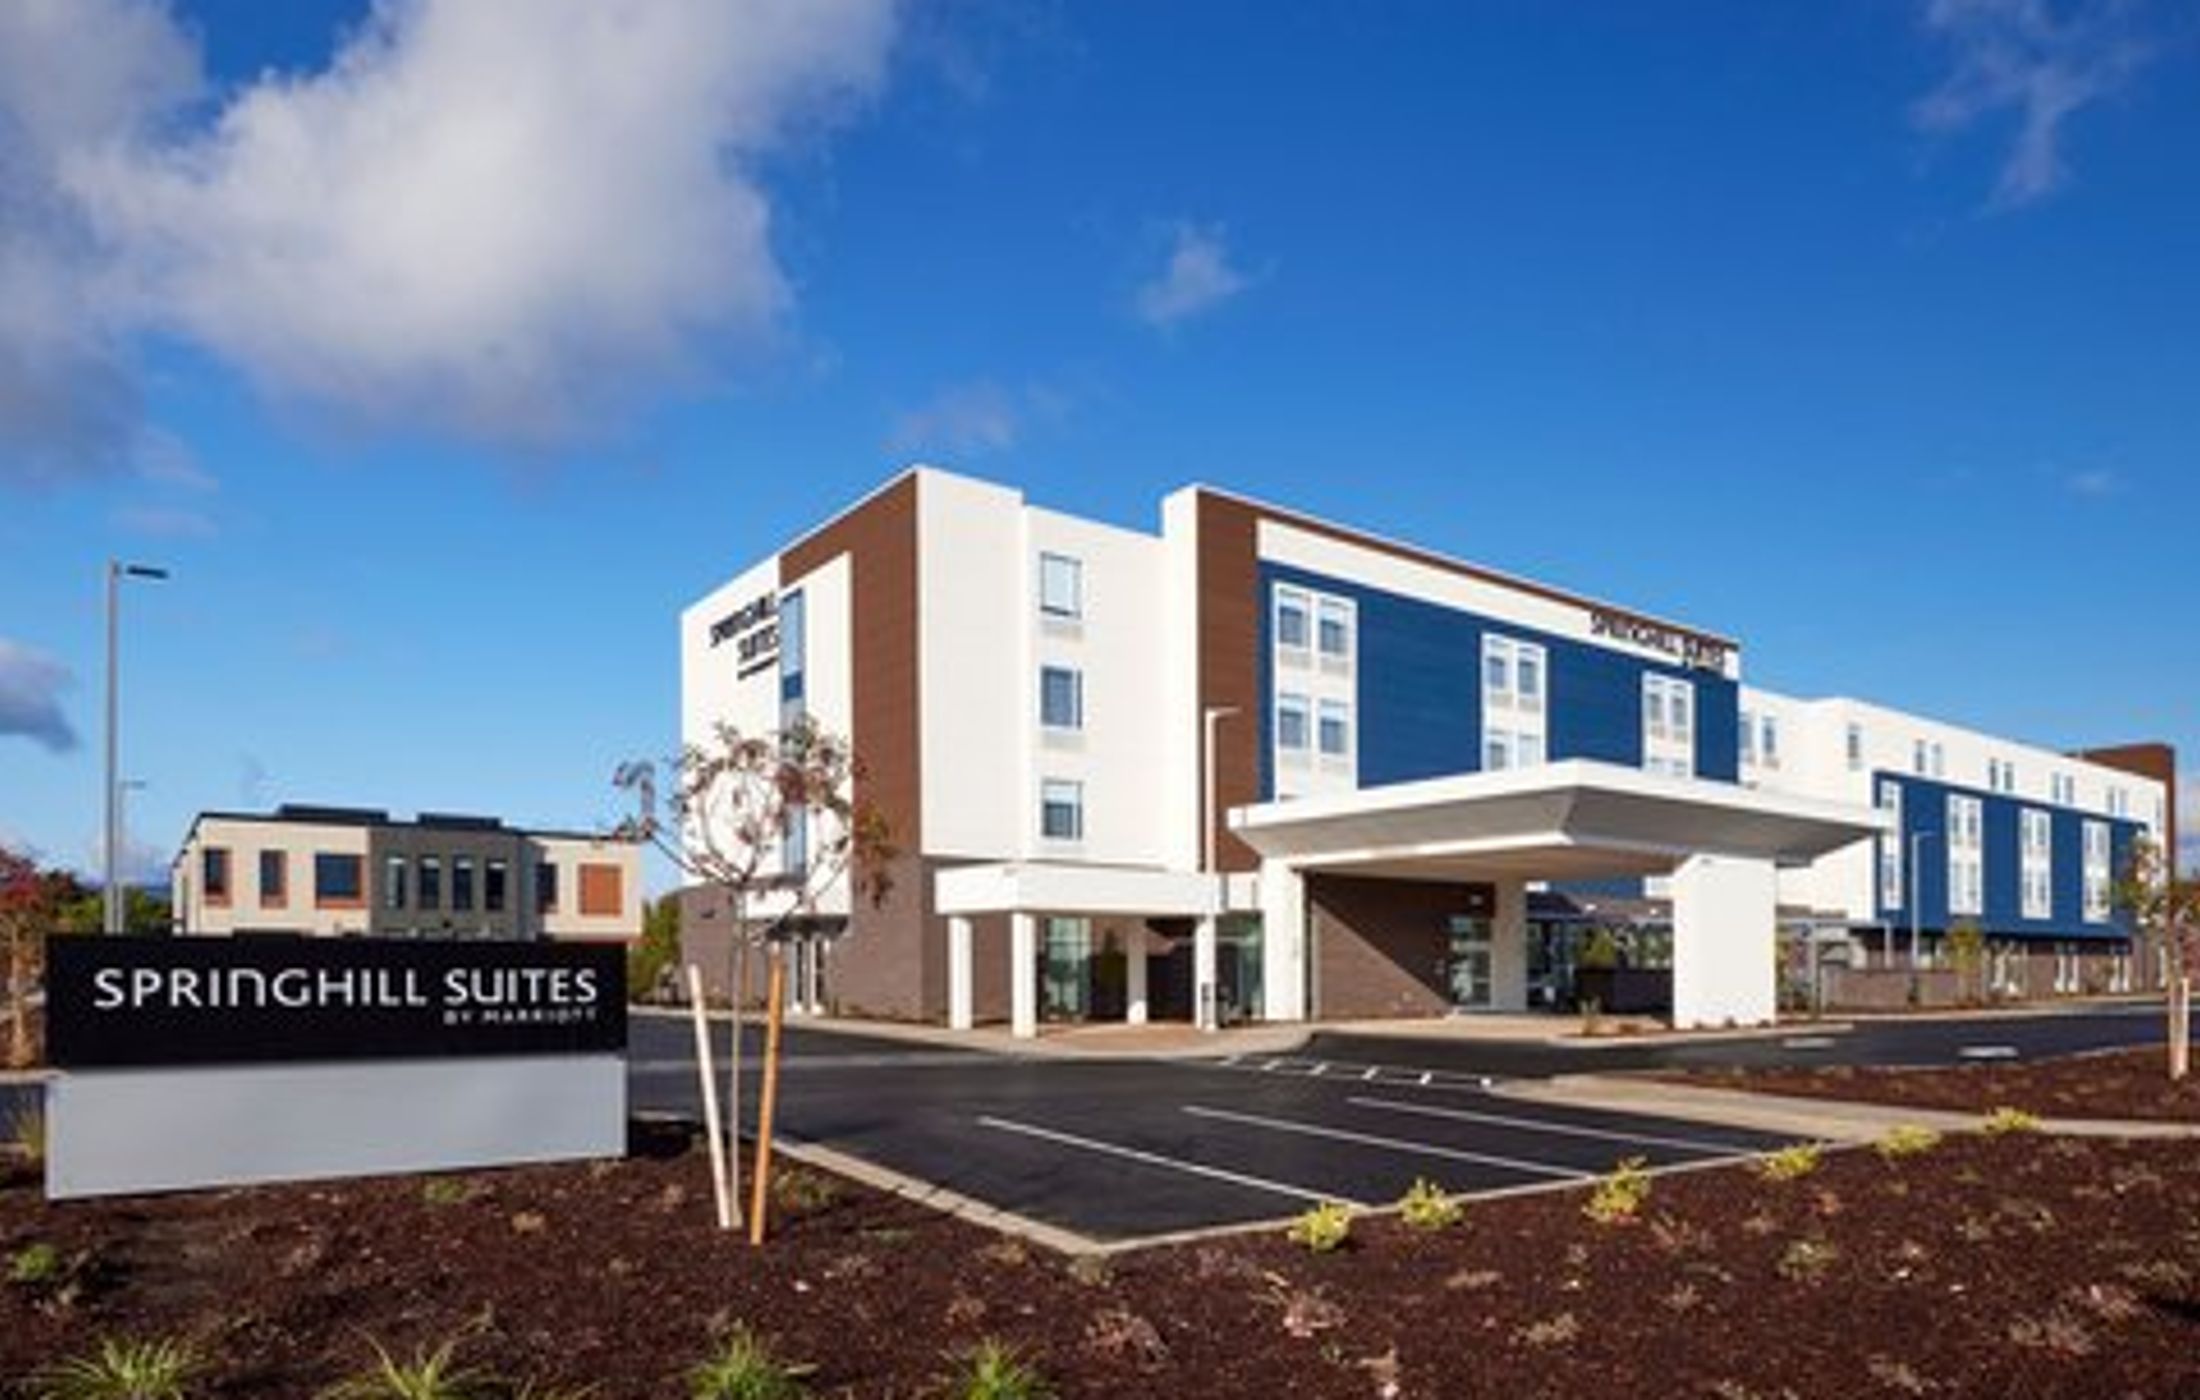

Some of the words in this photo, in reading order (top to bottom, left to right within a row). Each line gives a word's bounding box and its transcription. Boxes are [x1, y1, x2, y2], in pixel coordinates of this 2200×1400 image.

[94, 968, 428, 1008] SPRINGHILL
[443, 968, 598, 1005] SUITES
[443, 1010, 472, 1025] BY
[483, 1007, 597, 1024] MARRIOTT
